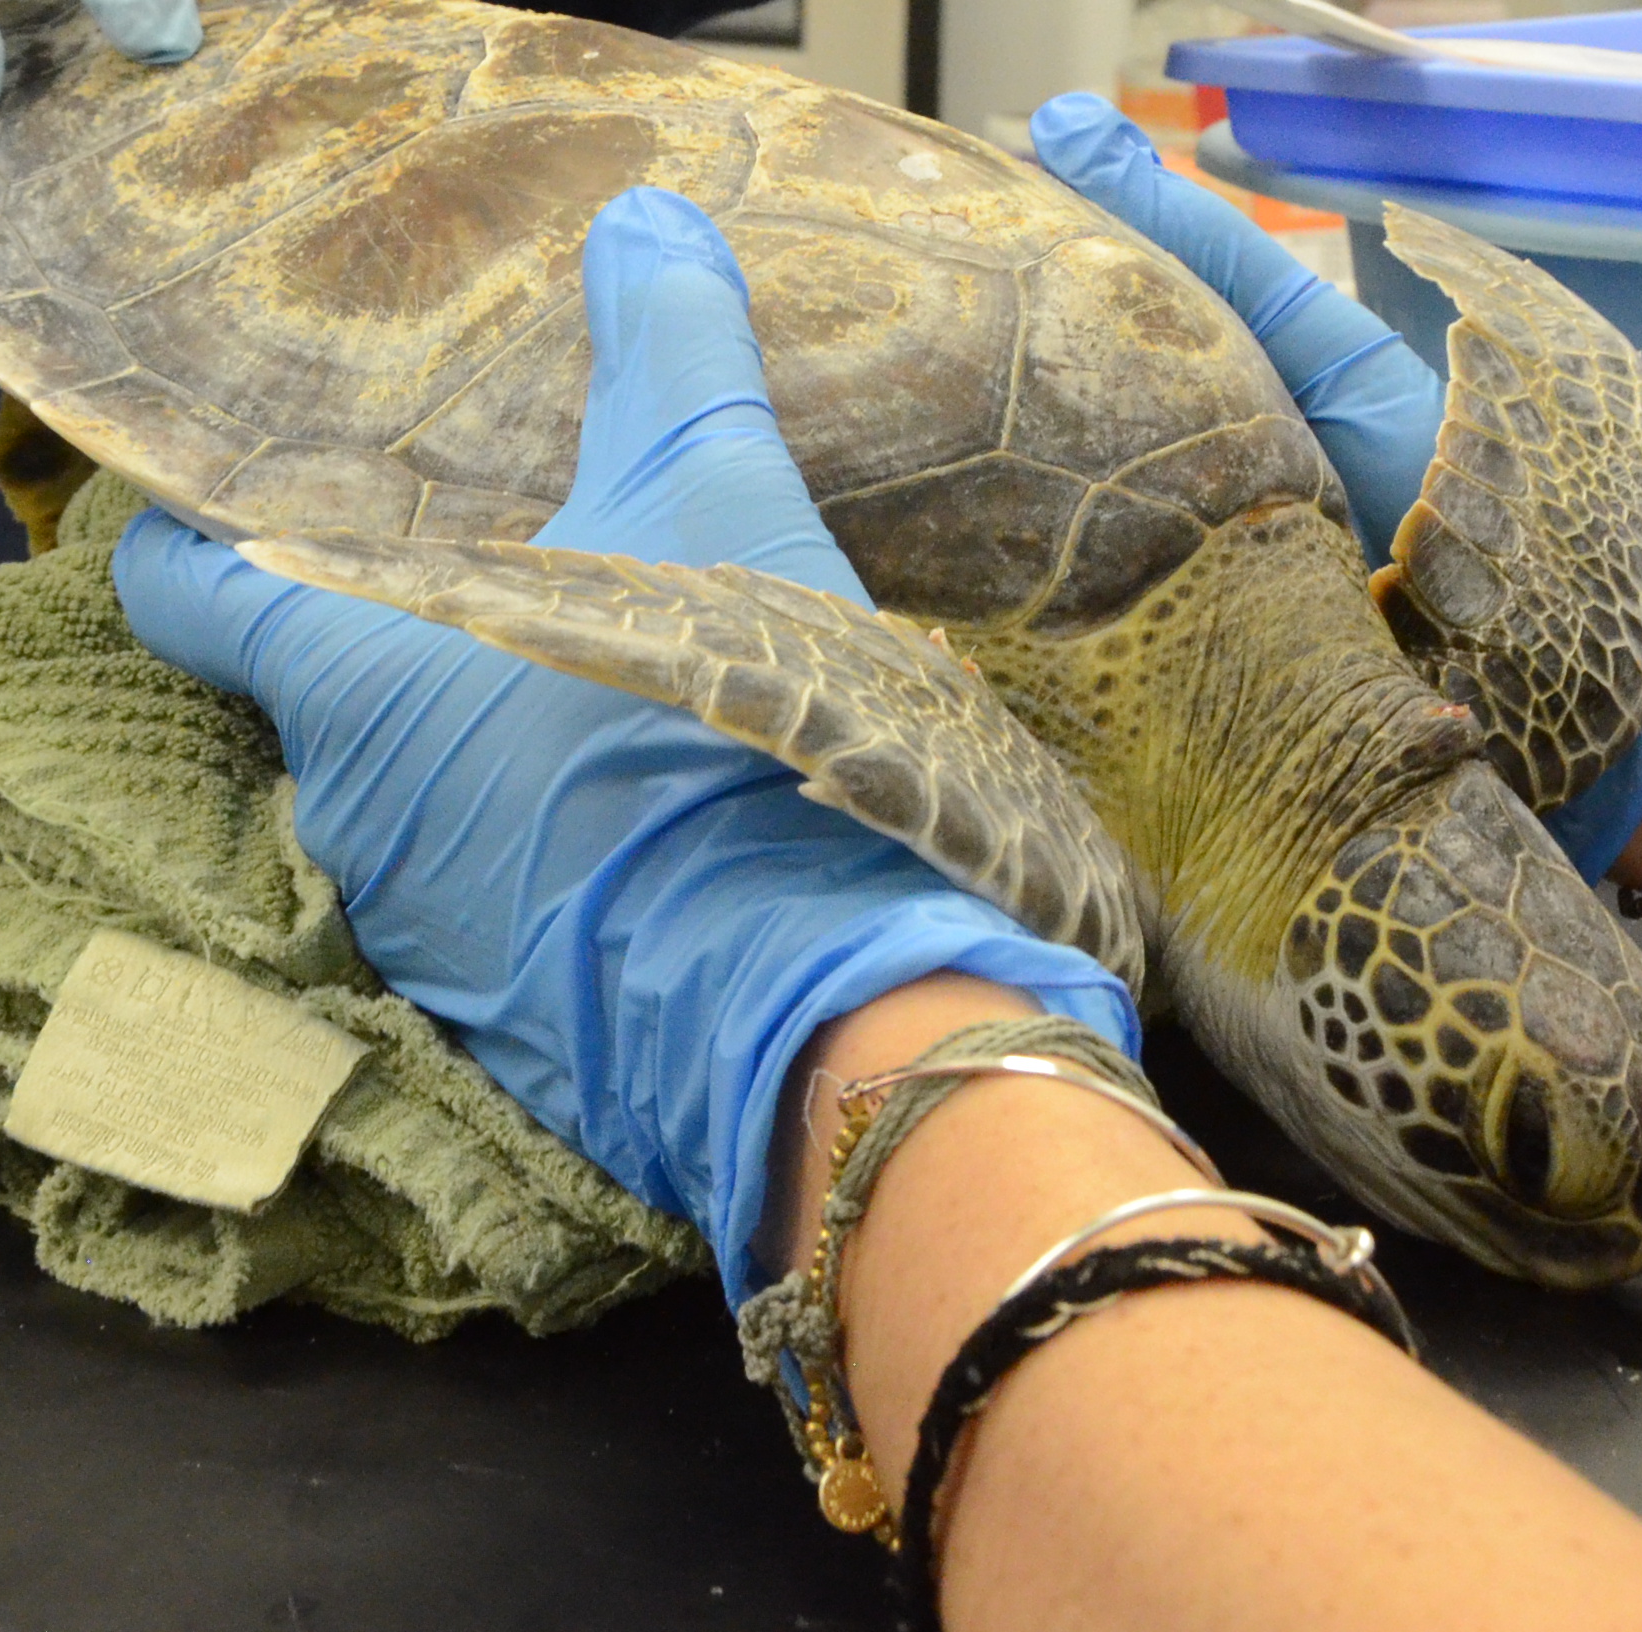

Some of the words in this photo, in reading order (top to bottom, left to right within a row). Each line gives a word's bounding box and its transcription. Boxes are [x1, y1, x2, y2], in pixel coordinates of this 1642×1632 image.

[123, 1044, 164, 1070] LOW
[153, 1031, 223, 1068] COLORS
[103, 1060, 170, 1093] BLEACH
[220, 1055, 271, 1085] DARK
[95, 1079, 117, 1097] TO
[118, 1086, 145, 1106] UP
[170, 1082, 206, 1105] NOT
[202, 1072, 272, 1107] TUMBLE
[90, 1097, 161, 1134] COTTON
[141, 1093, 192, 1123] WASH
[204, 1093, 232, 1115] DO
[48, 1109, 127, 1155] Collection
[190, 1110, 269, 1150] MACHINE
